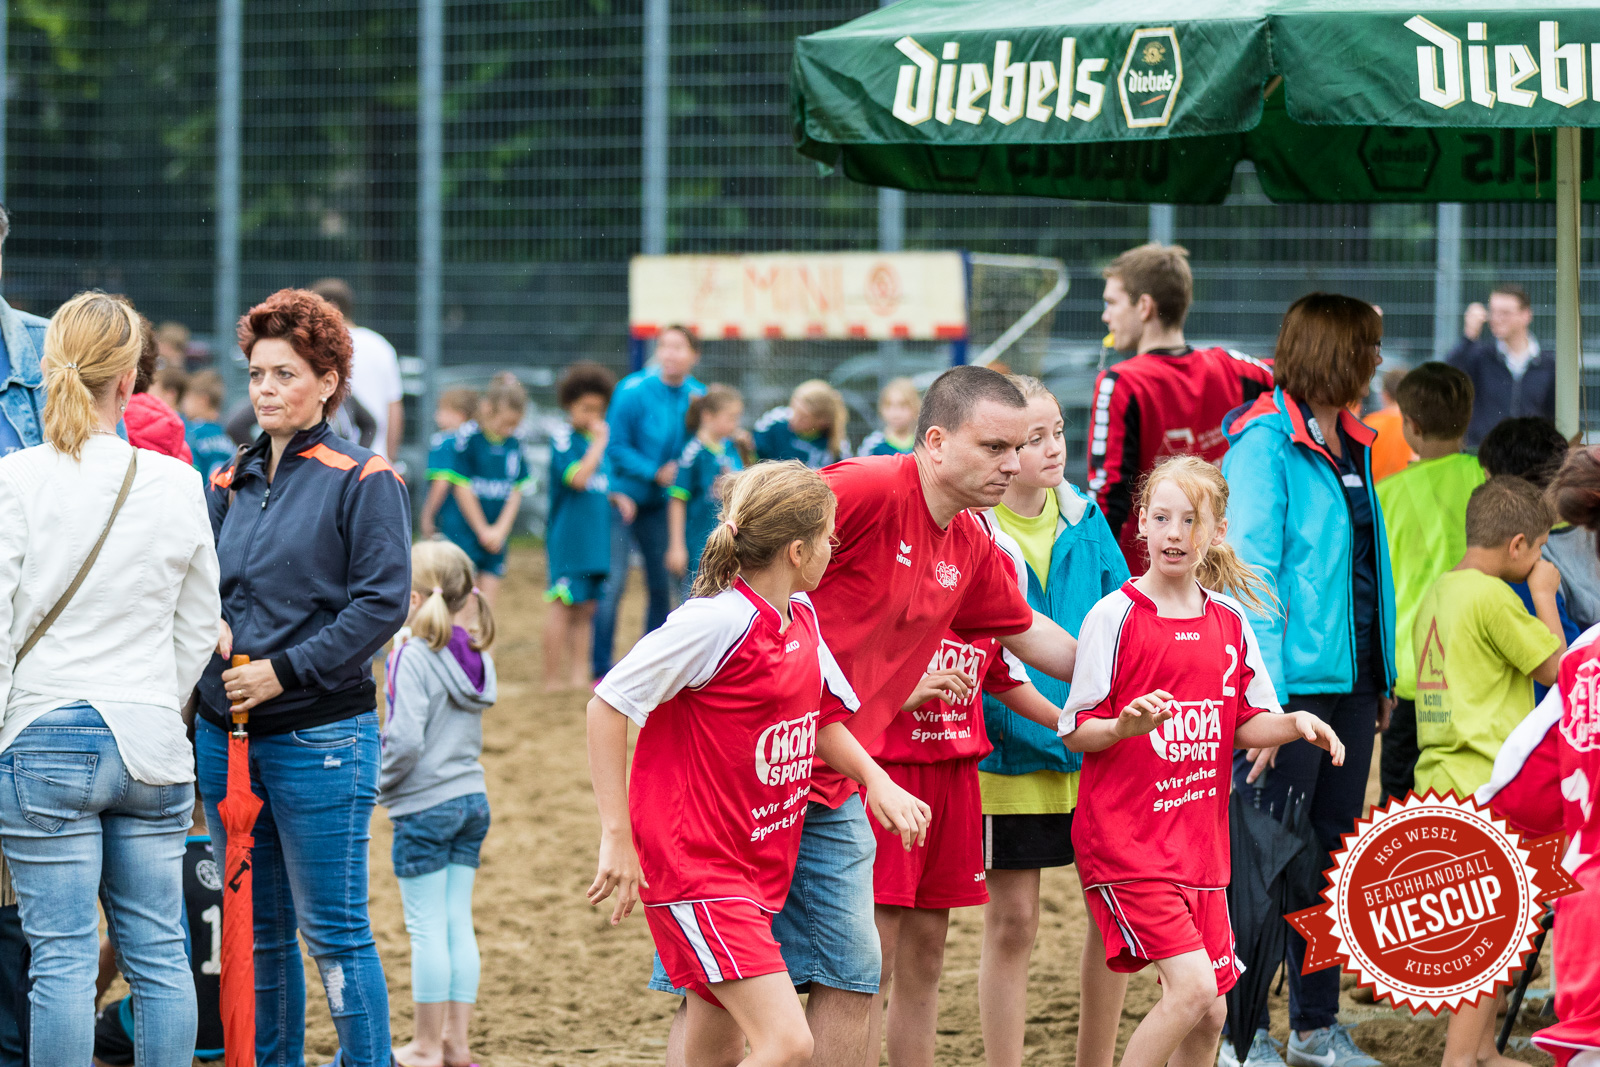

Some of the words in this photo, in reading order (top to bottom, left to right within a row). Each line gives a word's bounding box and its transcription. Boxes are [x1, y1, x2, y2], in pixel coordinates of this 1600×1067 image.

[1174, 632, 1201, 641] JAKO
[1222, 644, 1238, 697] 2
[912, 711, 941, 722] Wir
[1168, 742, 1220, 762] SPORT
[769, 757, 813, 786] SPORT
[1155, 776, 1183, 792] Wir
[751, 802, 780, 820] Wir
[201, 904, 221, 975] 1
